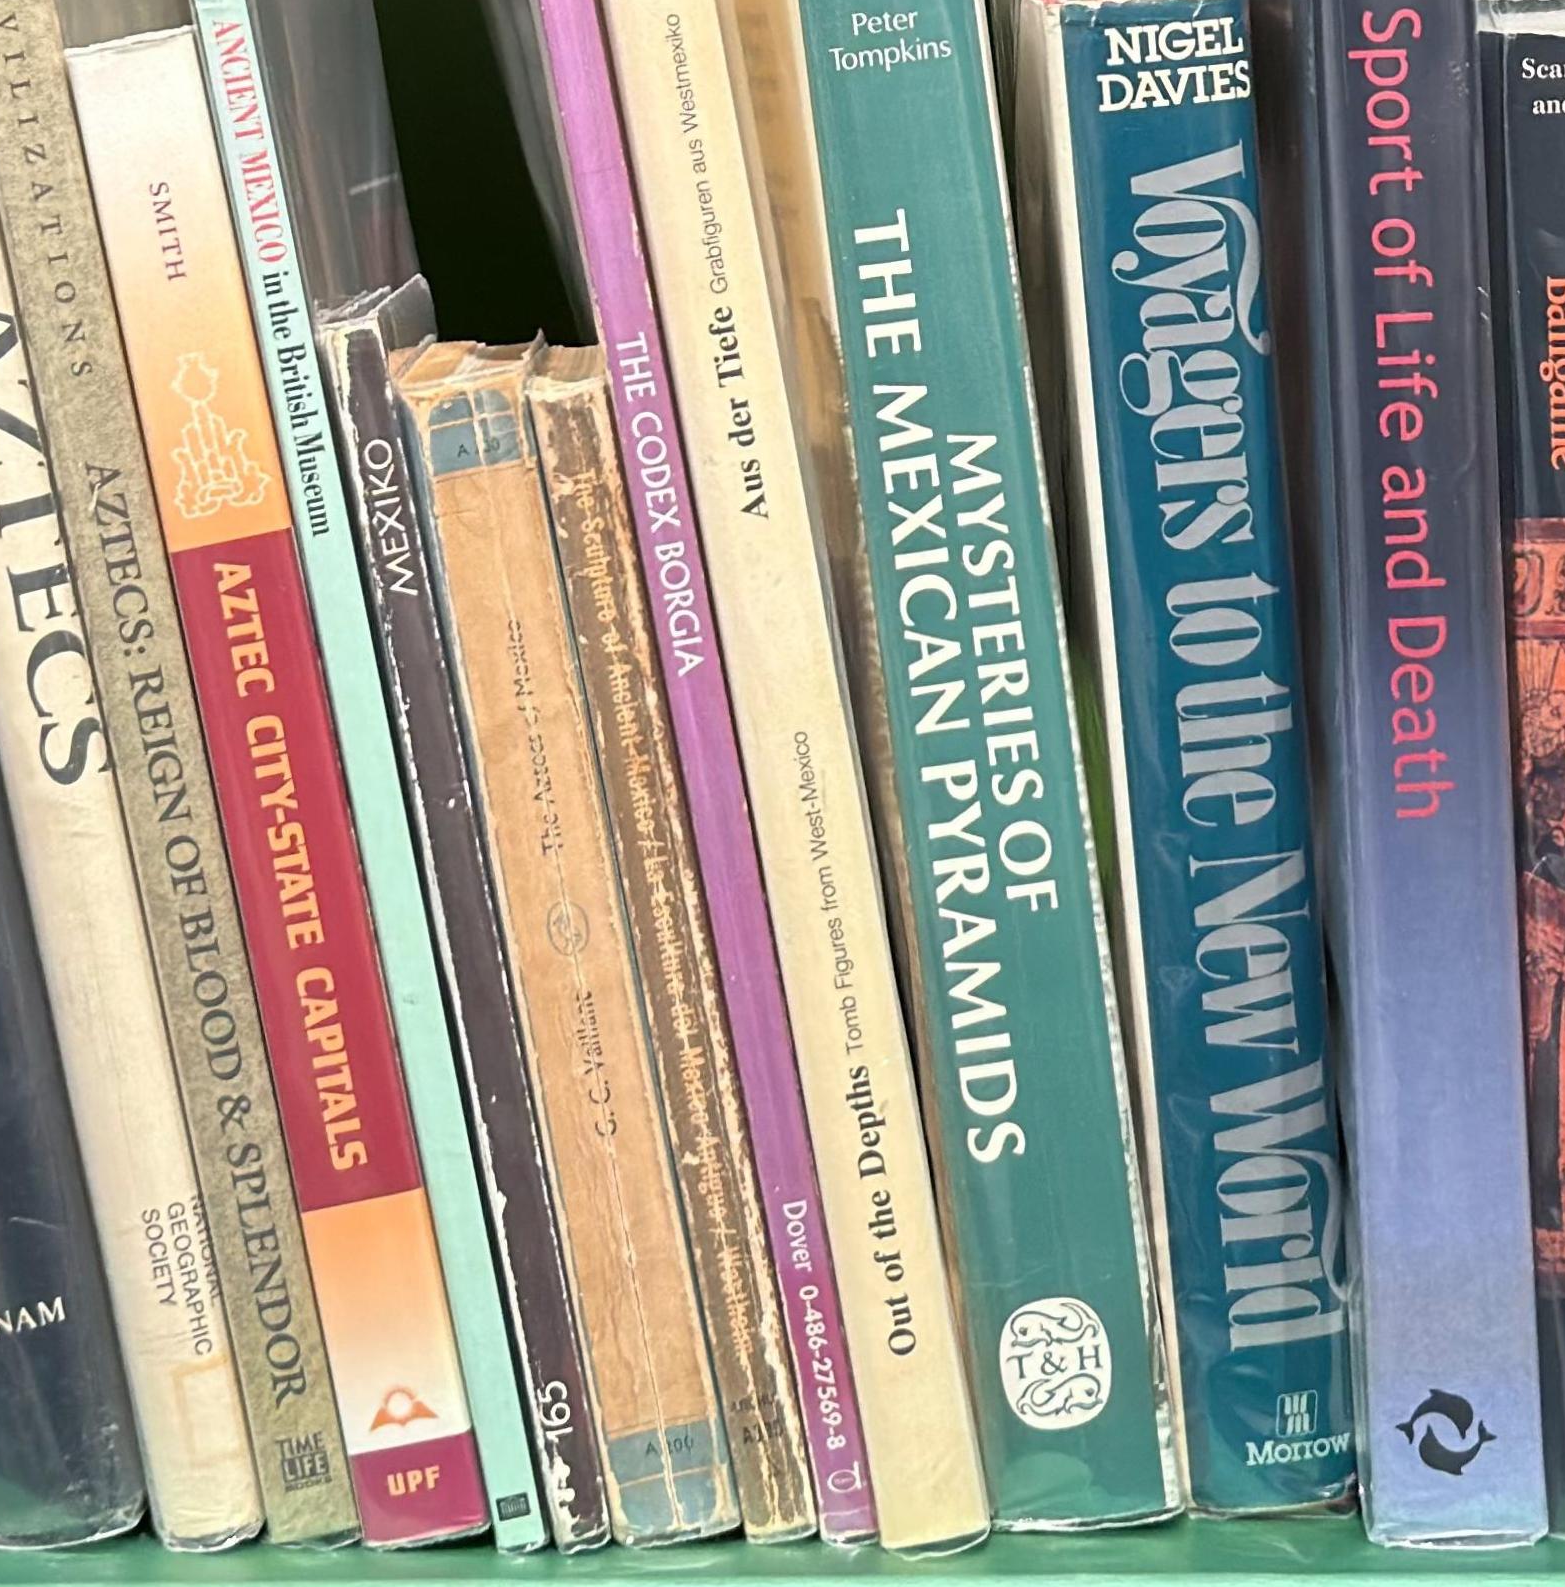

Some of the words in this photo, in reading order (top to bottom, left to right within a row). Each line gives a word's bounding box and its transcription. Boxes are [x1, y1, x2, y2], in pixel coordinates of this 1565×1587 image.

[665, 13, 699, 134] Westmexiko
[828, 36, 953, 72] Tompkins
[851, 9, 920, 36] Peter
[1103, 16, 1244, 68] NIGEL
[1096, 58, 1252, 113] DAVIES
[1347, 8, 1424, 197] Sport
[688, 138, 708, 175] aus
[149, 181, 187, 282] SMITH
[695, 178, 729, 295] Grabfiguren
[853, 208, 923, 359] THE
[1370, 217, 1434, 289] of
[616, 331, 658, 404] THE
[708, 304, 746, 389] Tiefe
[1111, 139, 1271, 551] Voyagers
[1374, 311, 1439, 443] Life
[630, 410, 682, 534] CODEX
[727, 396, 756, 449] der
[363, 438, 419, 598] MEXIKO
[739, 457, 770, 521] Aus
[1381, 465, 1447, 591] and
[85, 461, 155, 659] AZTECS:
[653, 541, 706, 678] BORGIA
[872, 383, 972, 736] MEXICAN
[1165, 571, 1281, 667] to
[945, 432, 1046, 807] MYSTERIES
[997, 820, 1060, 912] OF
[1387, 615, 1457, 820] Death
[128, 663, 194, 824] REIGN
[1174, 670, 1294, 829] the
[164, 834, 209, 899] OF
[212, 562, 276, 699] AZTEC
[245, 713, 326, 950] CITY-STATE
[296, 965, 368, 1172] CAPITALS
[179, 906, 245, 1082] BLOOD
[920, 759, 1027, 1165] PYRAMIDS
[1188, 848, 1311, 1054] New
[215, 1094, 254, 1132] &
[141, 1207, 177, 1308] SOCIETY
[1209, 1060, 1349, 1353] World
[166, 1201, 214, 1357] GEOGRAPHIC
[226, 1141, 308, 1411] SPLENDOR
[275, 1432, 325, 1456] TIME
[281, 1453, 330, 1479] LIFE
[386, 1465, 441, 1497] UPF
[1246, 1432, 1352, 1467] Morrow
